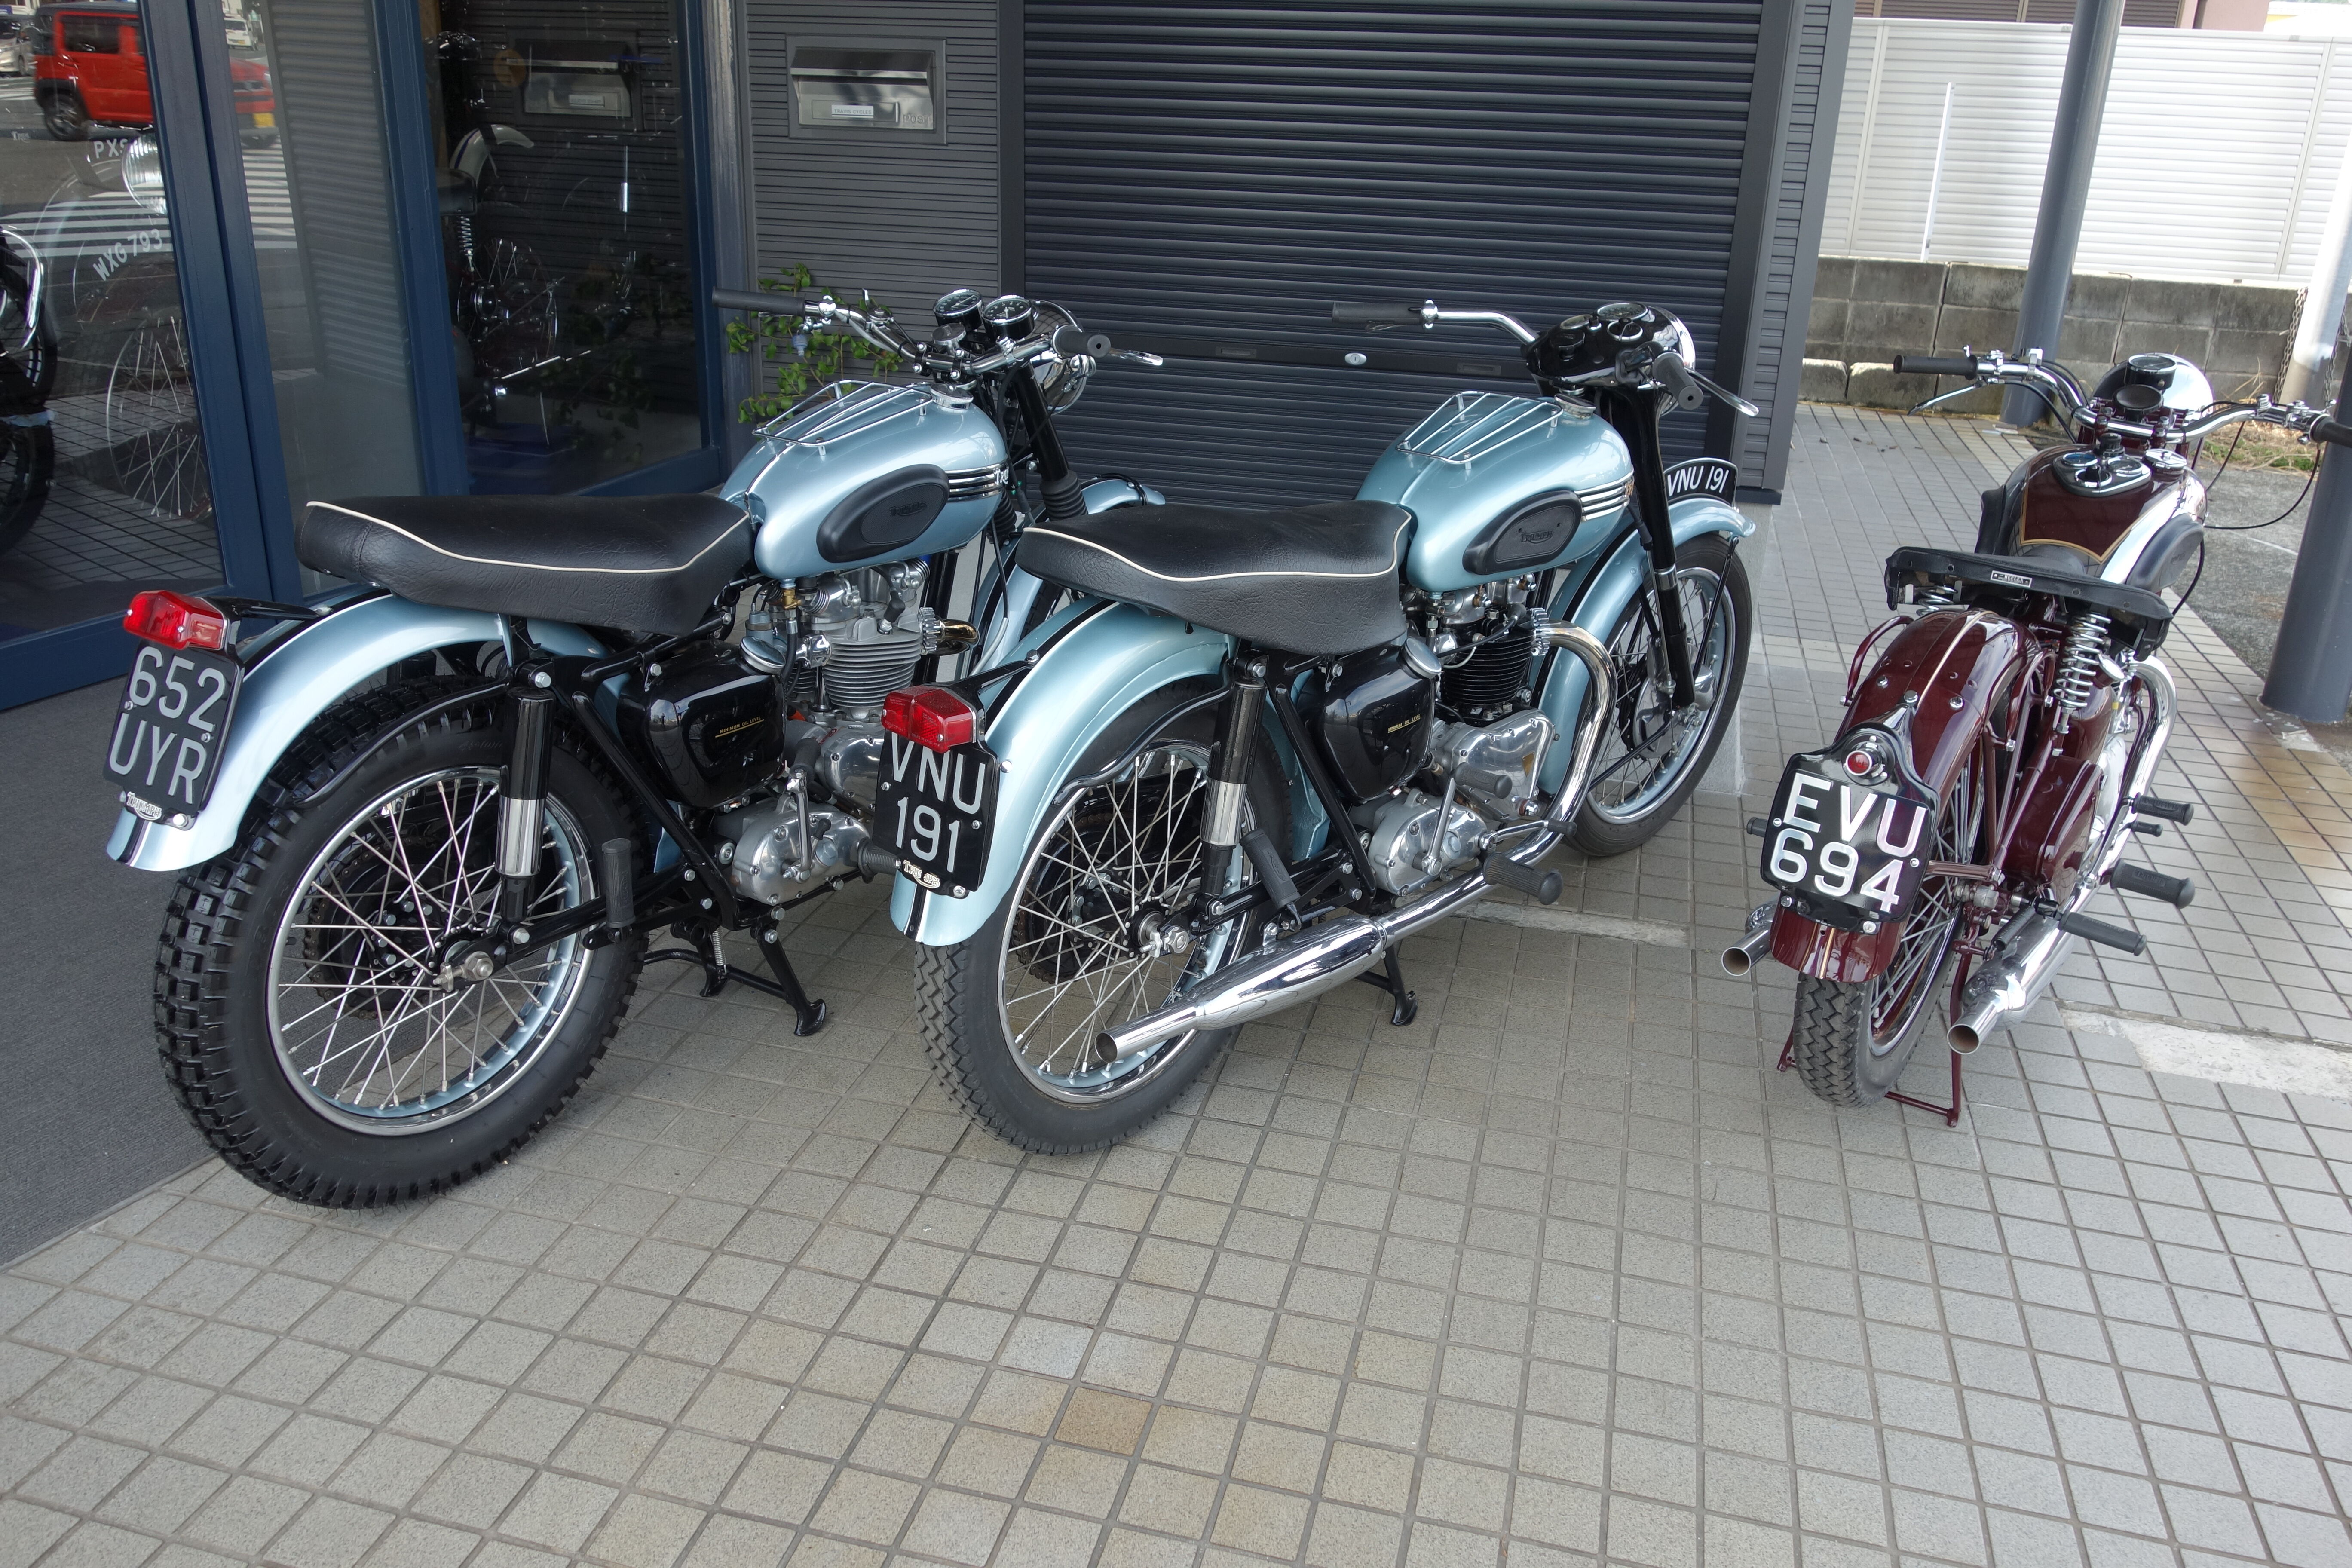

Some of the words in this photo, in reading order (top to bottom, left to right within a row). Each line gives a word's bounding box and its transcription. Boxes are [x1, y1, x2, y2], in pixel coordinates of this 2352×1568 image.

[903, 114, 932, 124] POST
[93, 242, 128, 281] WXG
[127, 229, 162, 257] 793
[1667, 466, 1704, 496] VNU
[1705, 466, 1729, 493] 191
[129, 646, 217, 732] 652
[109, 712, 207, 805] UYR
[720, 724, 740, 733] MINIMUM
[126, 791, 162, 819] TRIUMPH
[891, 731, 986, 815] VNU
[896, 797, 960, 873] 191
[1783, 772, 1927, 858] EVU
[1770, 828, 1904, 913] 694
